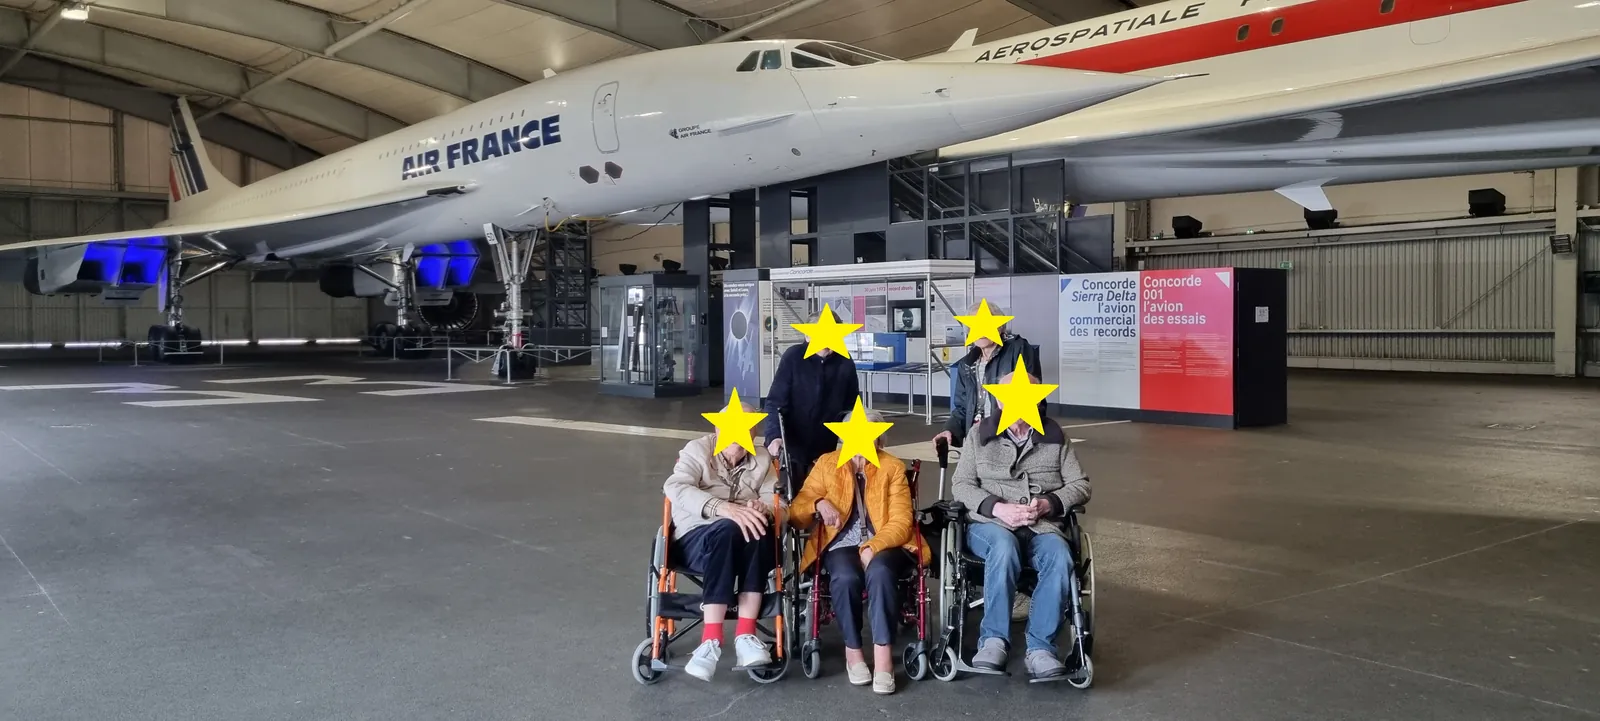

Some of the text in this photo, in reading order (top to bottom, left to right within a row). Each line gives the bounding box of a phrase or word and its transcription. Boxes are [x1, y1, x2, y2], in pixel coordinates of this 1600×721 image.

[974, 2, 1205, 63] AEROSPATIALE
[689, 128, 712, 137] FRANCE
[402, 114, 562, 181] AIR FRANCE
[1082, 277, 1136, 290] Concorde
[1143, 275, 1202, 288] Concorde
[1072, 290, 1137, 302] Sierra Delta
[1143, 289, 1163, 300] 001
[1098, 302, 1136, 313] l'avion
[1143, 300, 1183, 312] l'avion
[1069, 314, 1136, 326] commercial
[1143, 312, 1206, 325] des essais
[1070, 326, 1136, 338] des records
